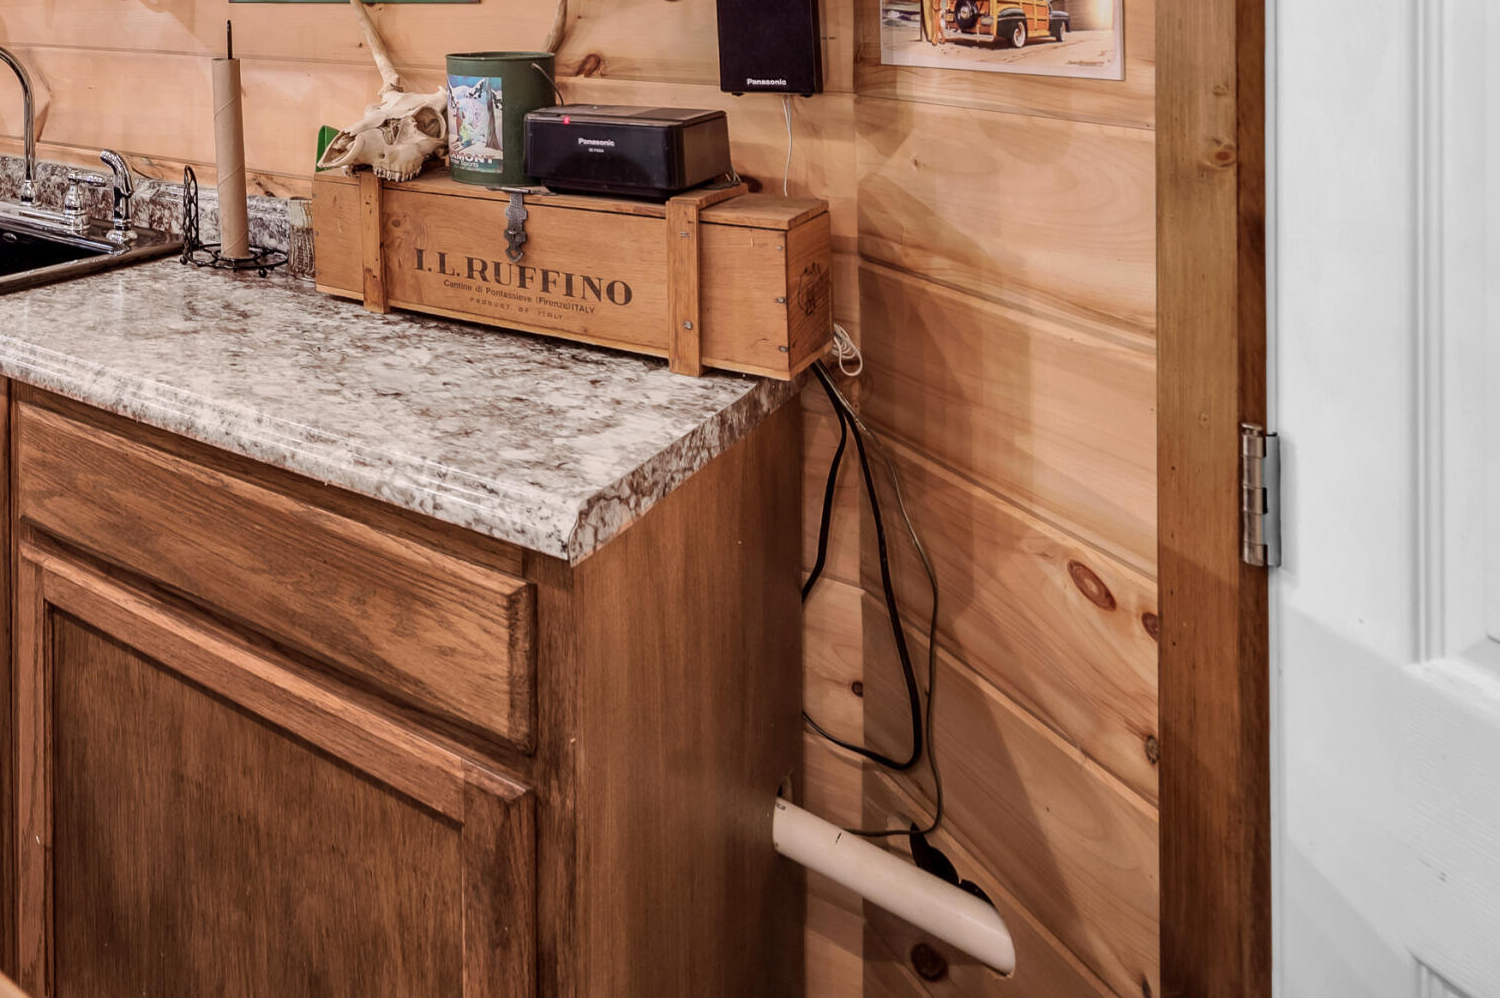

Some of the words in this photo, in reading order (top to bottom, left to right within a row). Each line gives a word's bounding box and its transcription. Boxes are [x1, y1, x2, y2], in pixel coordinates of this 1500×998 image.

[745, 78, 787, 86] Panasonic
[578, 137, 615, 146] Panasonic
[475, 285, 483, 293] di
